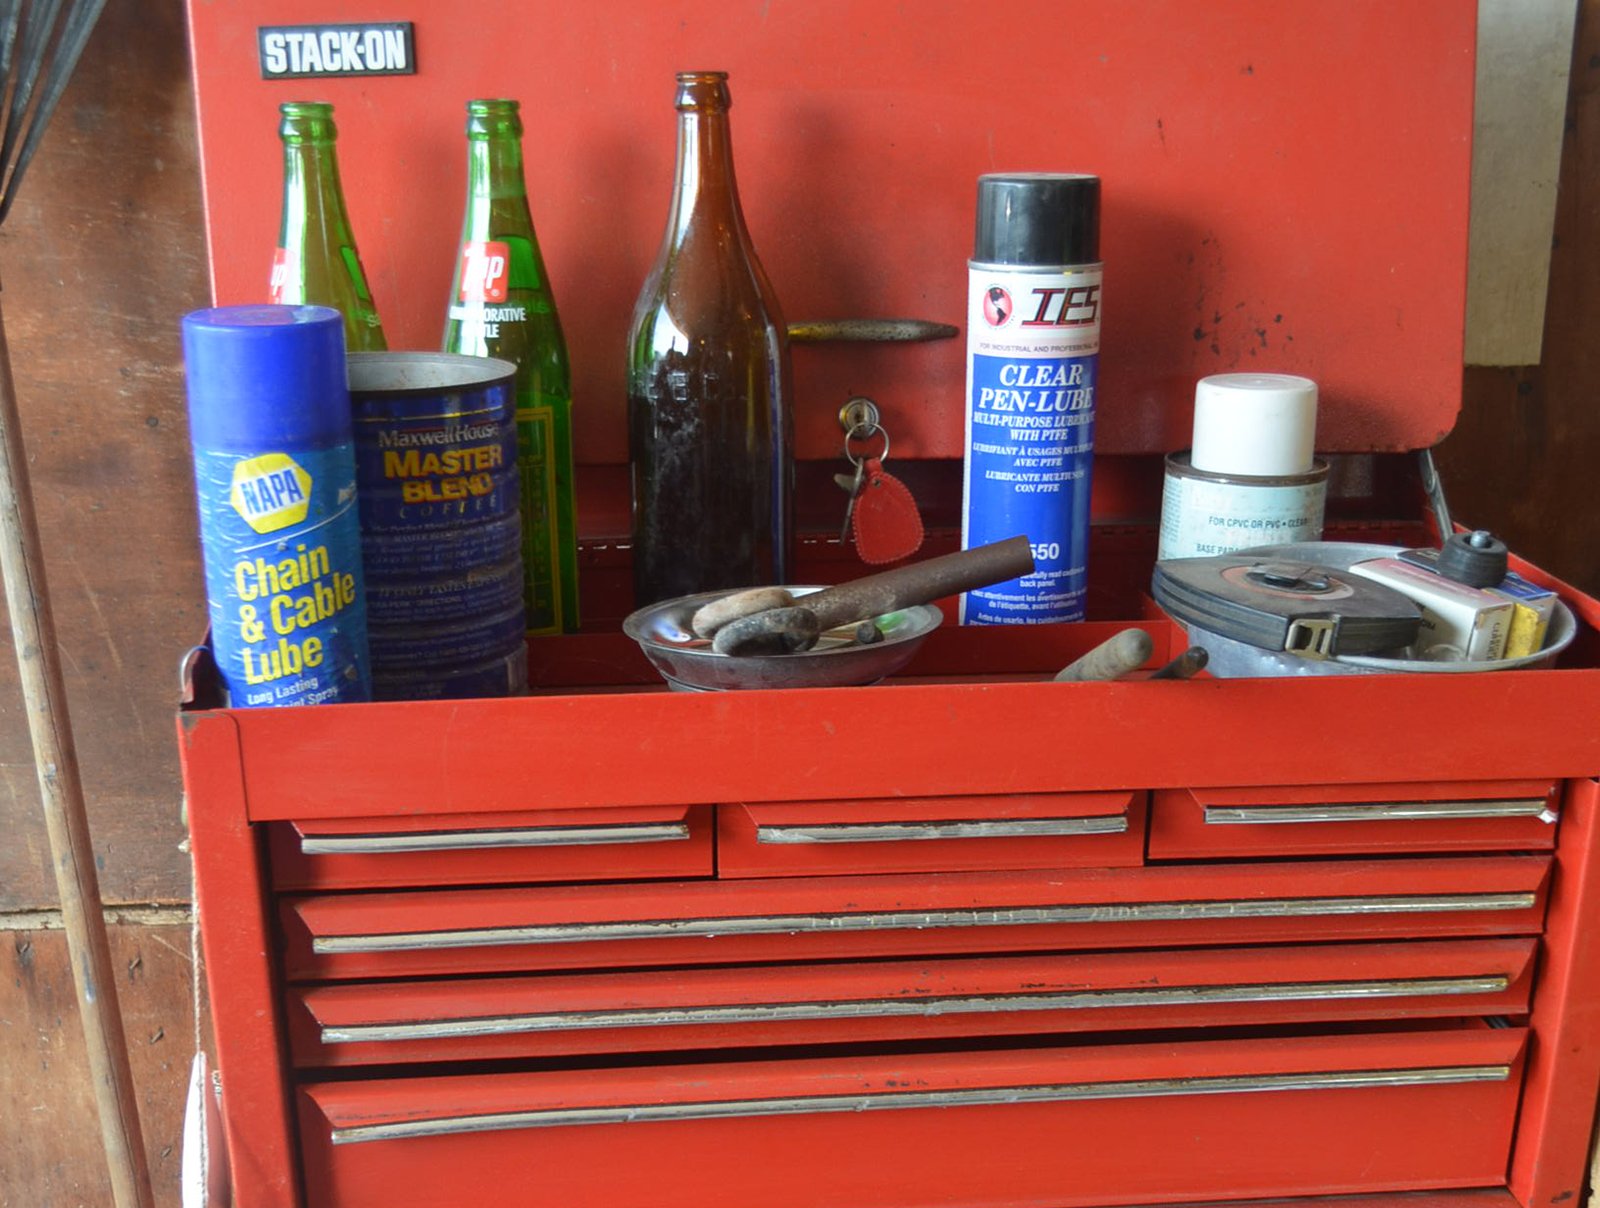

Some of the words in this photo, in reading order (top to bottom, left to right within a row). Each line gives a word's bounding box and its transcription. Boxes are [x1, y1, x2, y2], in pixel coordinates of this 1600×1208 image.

[991, 344, 1031, 353] INDUSTRIAL
[1033, 345, 1050, 353] AND
[1000, 363, 1084, 387] CLEAR
[978, 387, 1094, 413] PEN-LUBE
[973, 411, 1053, 428] MULTI-PURPOSE
[378, 423, 456, 448] Maxwell
[1010, 428, 1040, 441] WITH
[1042, 428, 1069, 442] PTFE
[383, 443, 504, 480] MASTER
[1013, 457, 1040, 467] AVEC
[1039, 457, 1064, 467] PTFE
[1027, 446, 1064, 457] USAGES
[401, 471, 496, 505] BLEND
[985, 470, 1041, 482] LUBRICANTE
[1014, 483, 1036, 493] CON
[1036, 483, 1061, 493] PTFE
[240, 468, 305, 515] NAPA
[1208, 516, 1225, 526] FOR
[1226, 518, 1249, 529] CPVC
[1250, 519, 1263, 529] OR
[1264, 519, 1281, 529] PVC
[234, 543, 331, 602] Chain
[1019, 580, 1036, 588] back
[238, 604, 267, 644] &
[269, 571, 356, 636] Cable
[241, 636, 324, 686] Lube
[246, 691, 274, 706] Long
[275, 677, 319, 699] Lasting
